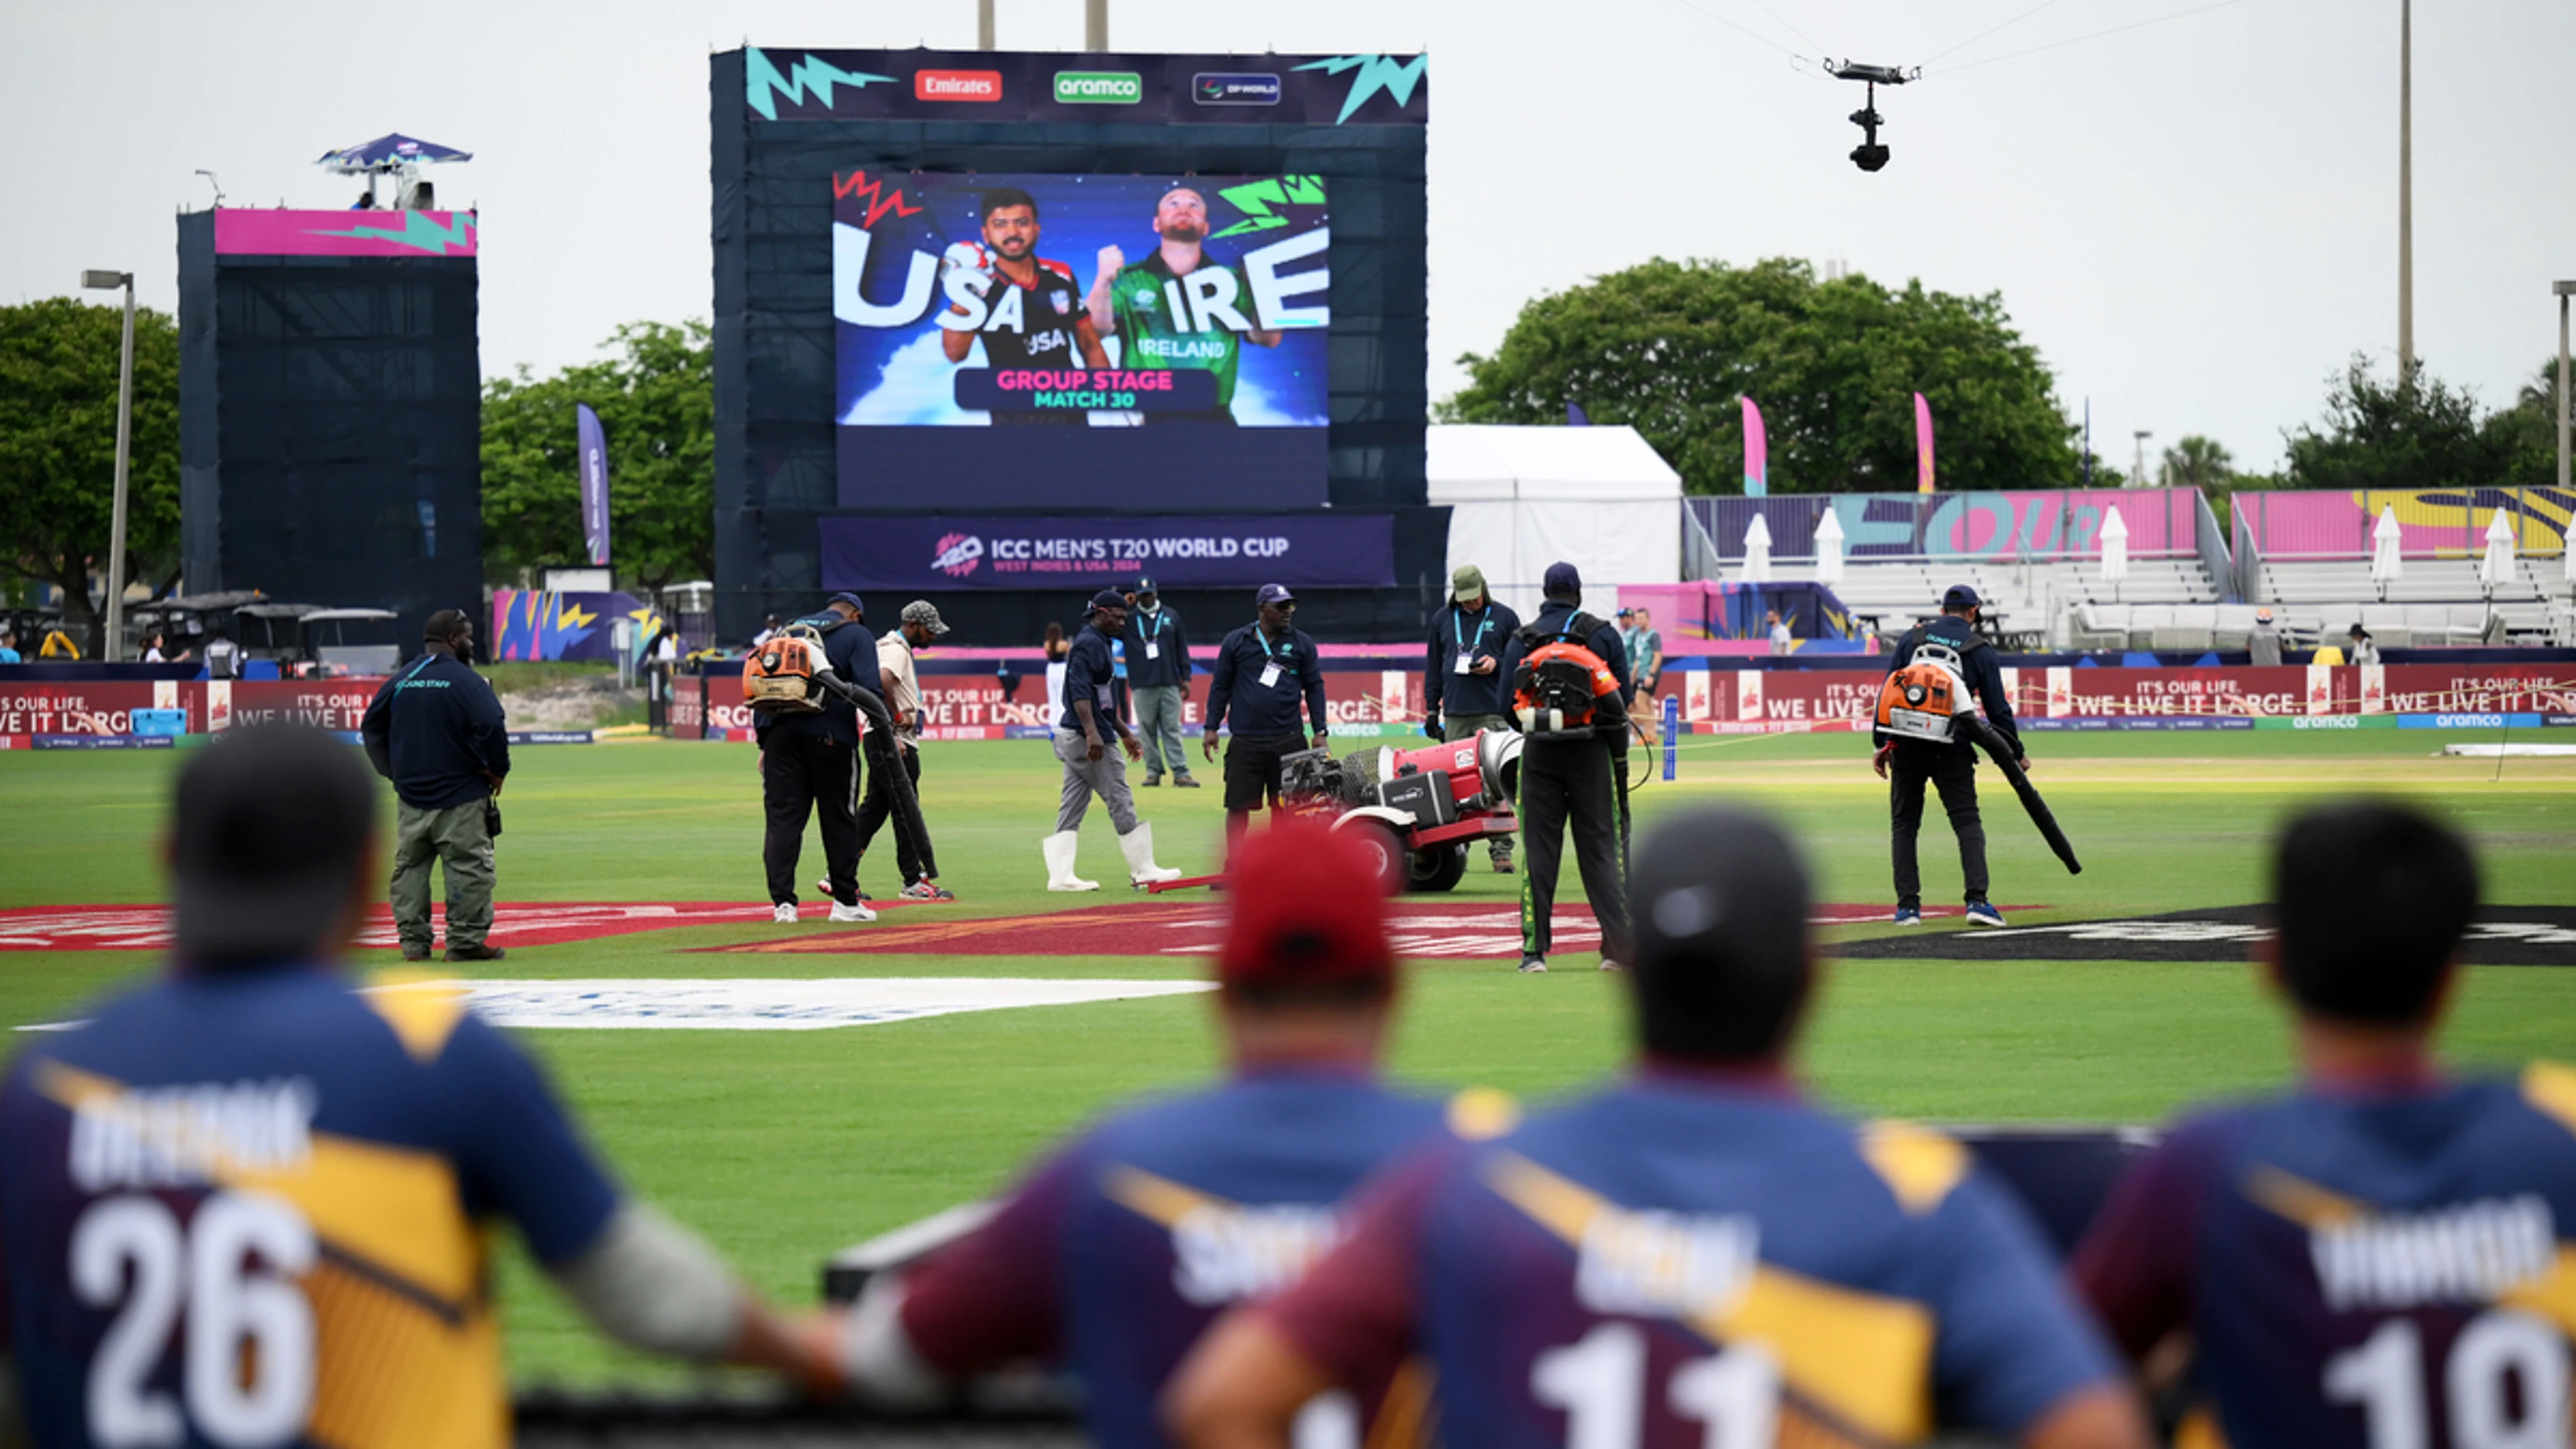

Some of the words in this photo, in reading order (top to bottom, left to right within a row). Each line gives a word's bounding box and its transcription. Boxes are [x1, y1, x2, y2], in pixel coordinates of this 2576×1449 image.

[925, 76, 992, 94] Emirates
[1059, 78, 1136, 95] aramco
[833, 221, 1025, 334] USA
[1163, 226, 1330, 333] IRE
[1138, 339, 1226, 359] IRELAND
[997, 370, 1088, 390] GROUP
[1094, 370, 1173, 390] STAGE
[1034, 391, 1107, 407] MATCH
[1110, 391, 1135, 407] 30
[991, 540, 1031, 559] ICC
[1034, 539, 1106, 559] MEN'S
[1113, 539, 1149, 558] T20
[1152, 538, 1238, 557] WORLD
[1243, 537, 1289, 557] CUP
[994, 561, 1028, 572] WEST
[1031, 561, 1073, 572] INDIES
[1084, 561, 1109, 572] USA
[1112, 561, 1142, 572] 2024
[1826, 684, 1854, 698] IT'S
[1858, 684, 1881, 698] OU
[2137, 680, 2164, 694] IT'S
[2168, 680, 2202, 694] OUR
[2206, 680, 2242, 694] LIFE.
[2451, 678, 2479, 691] IT'S
[2485, 678, 2518, 690] OUR
[297, 694, 325, 708] IT'S
[329, 694, 362, 708] OUR
[946, 689, 978, 702] OUR
[2391, 694, 2428, 711] WE
[2438, 693, 2491, 712] LIVE
[2500, 693, 2522, 710] IT
[15, 697, 48, 711] OUR
[54, 697, 89, 712] LIFE.
[1767, 698, 1806, 718] WE
[1814, 698, 1864, 718] LIVE
[2078, 695, 2115, 715] WE
[2125, 695, 2174, 715] LIVE
[2184, 694, 2206, 714] IT
[2214, 694, 2302, 714] LARGE.
[32, 712, 53, 733] IT
[961, 704, 983, 724] IT
[2293, 716, 2358, 729] aramco
[2436, 714, 2502, 727] aramco
[1329, 724, 1381, 737] ramco
[69, 1187, 319, 1449] 26
